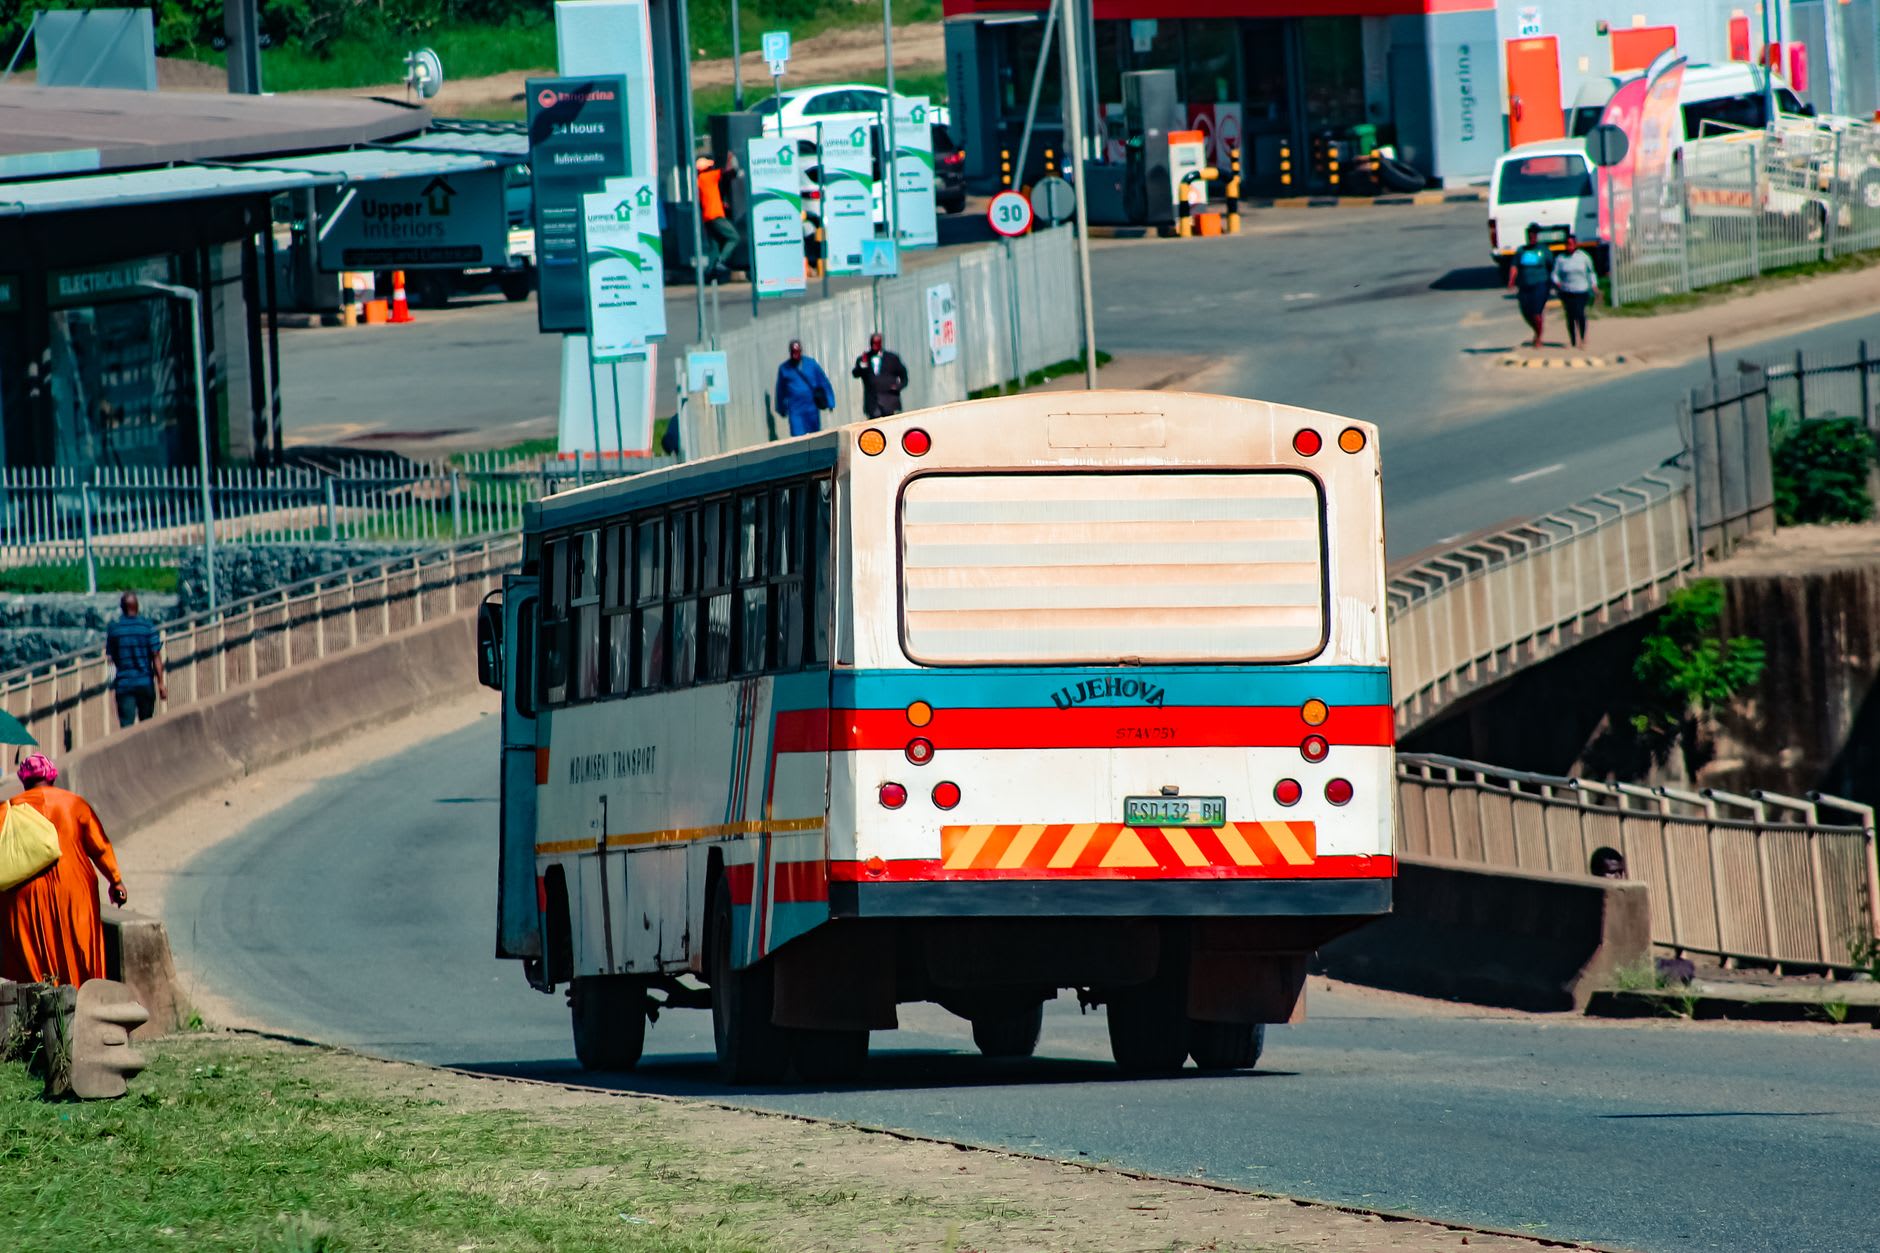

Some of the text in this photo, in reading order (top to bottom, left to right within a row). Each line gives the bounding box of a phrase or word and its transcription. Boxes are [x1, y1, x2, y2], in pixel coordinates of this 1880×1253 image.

[1455, 44, 1477, 142] tangerina
[570, 122, 605, 134] hours
[554, 152, 605, 165] lubricants
[361, 198, 423, 222] Upper
[999, 204, 1023, 223] 30
[1050, 676, 1166, 711] UJEHOVA
[613, 745, 656, 778] TRANSPORT
[1161, 803, 1190, 821] 132
[1203, 802, 1222, 821] BH
